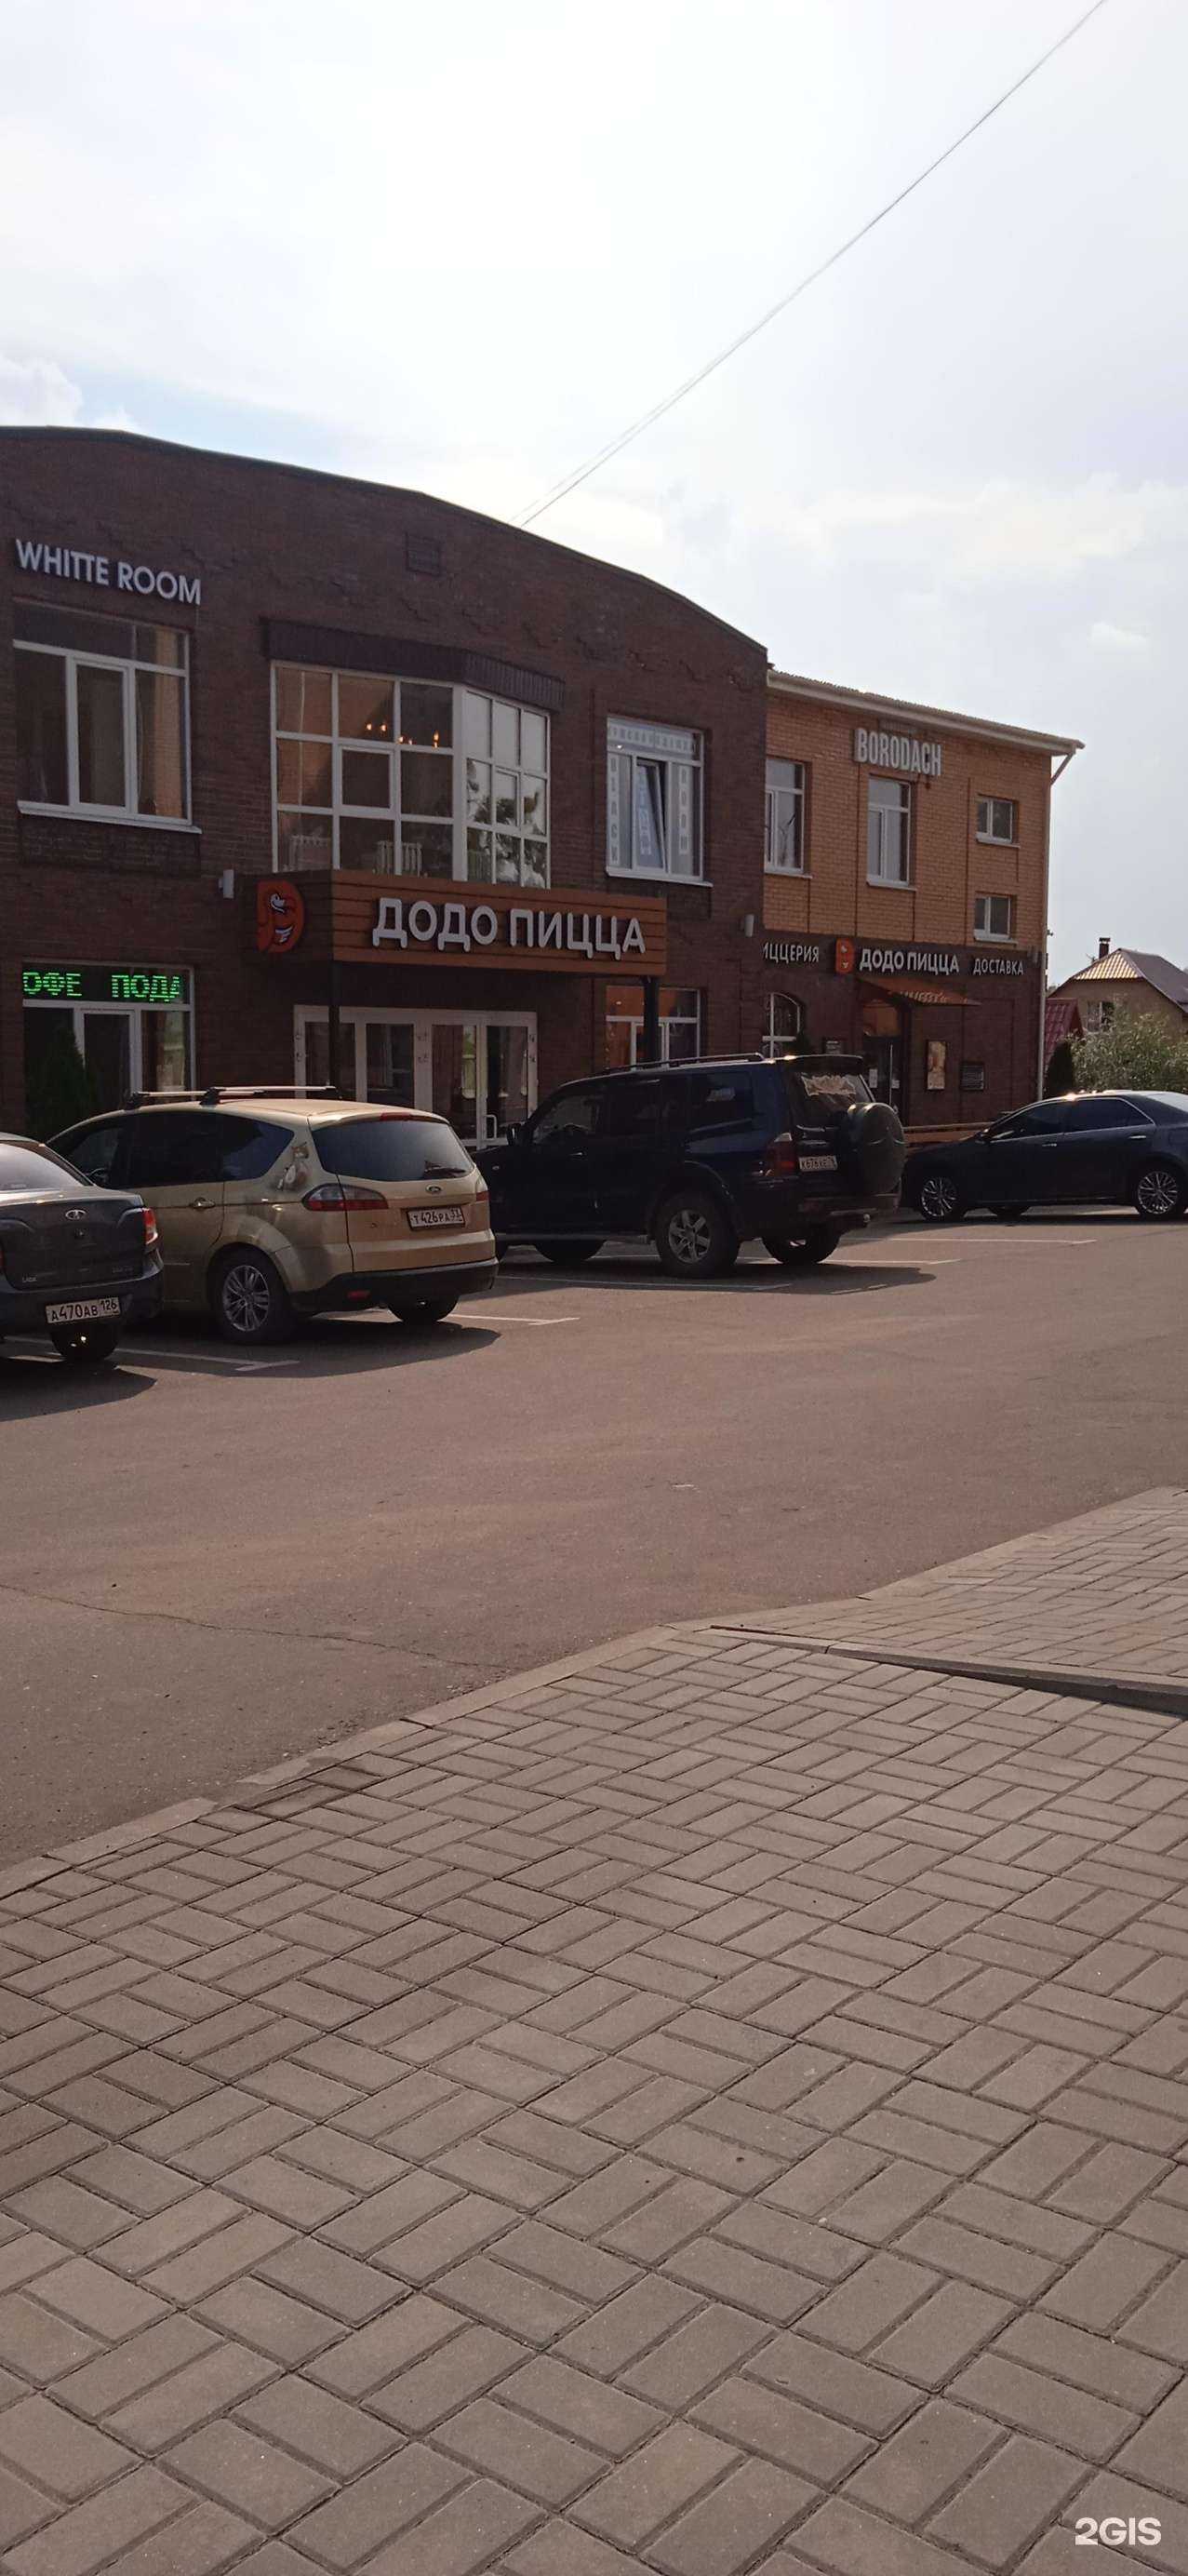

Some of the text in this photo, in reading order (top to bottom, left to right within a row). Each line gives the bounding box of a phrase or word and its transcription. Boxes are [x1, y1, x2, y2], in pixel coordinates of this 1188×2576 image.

[16, 539, 201, 605] WHITTE ROOM
[855, 728, 942, 775] BORODACH
[373, 897, 646, 960] ДОДО ПИЦЦА
[860, 948, 959, 975] ДОДО ПИЦЦА
[973, 958, 1023, 975] ДОСТАВКА
